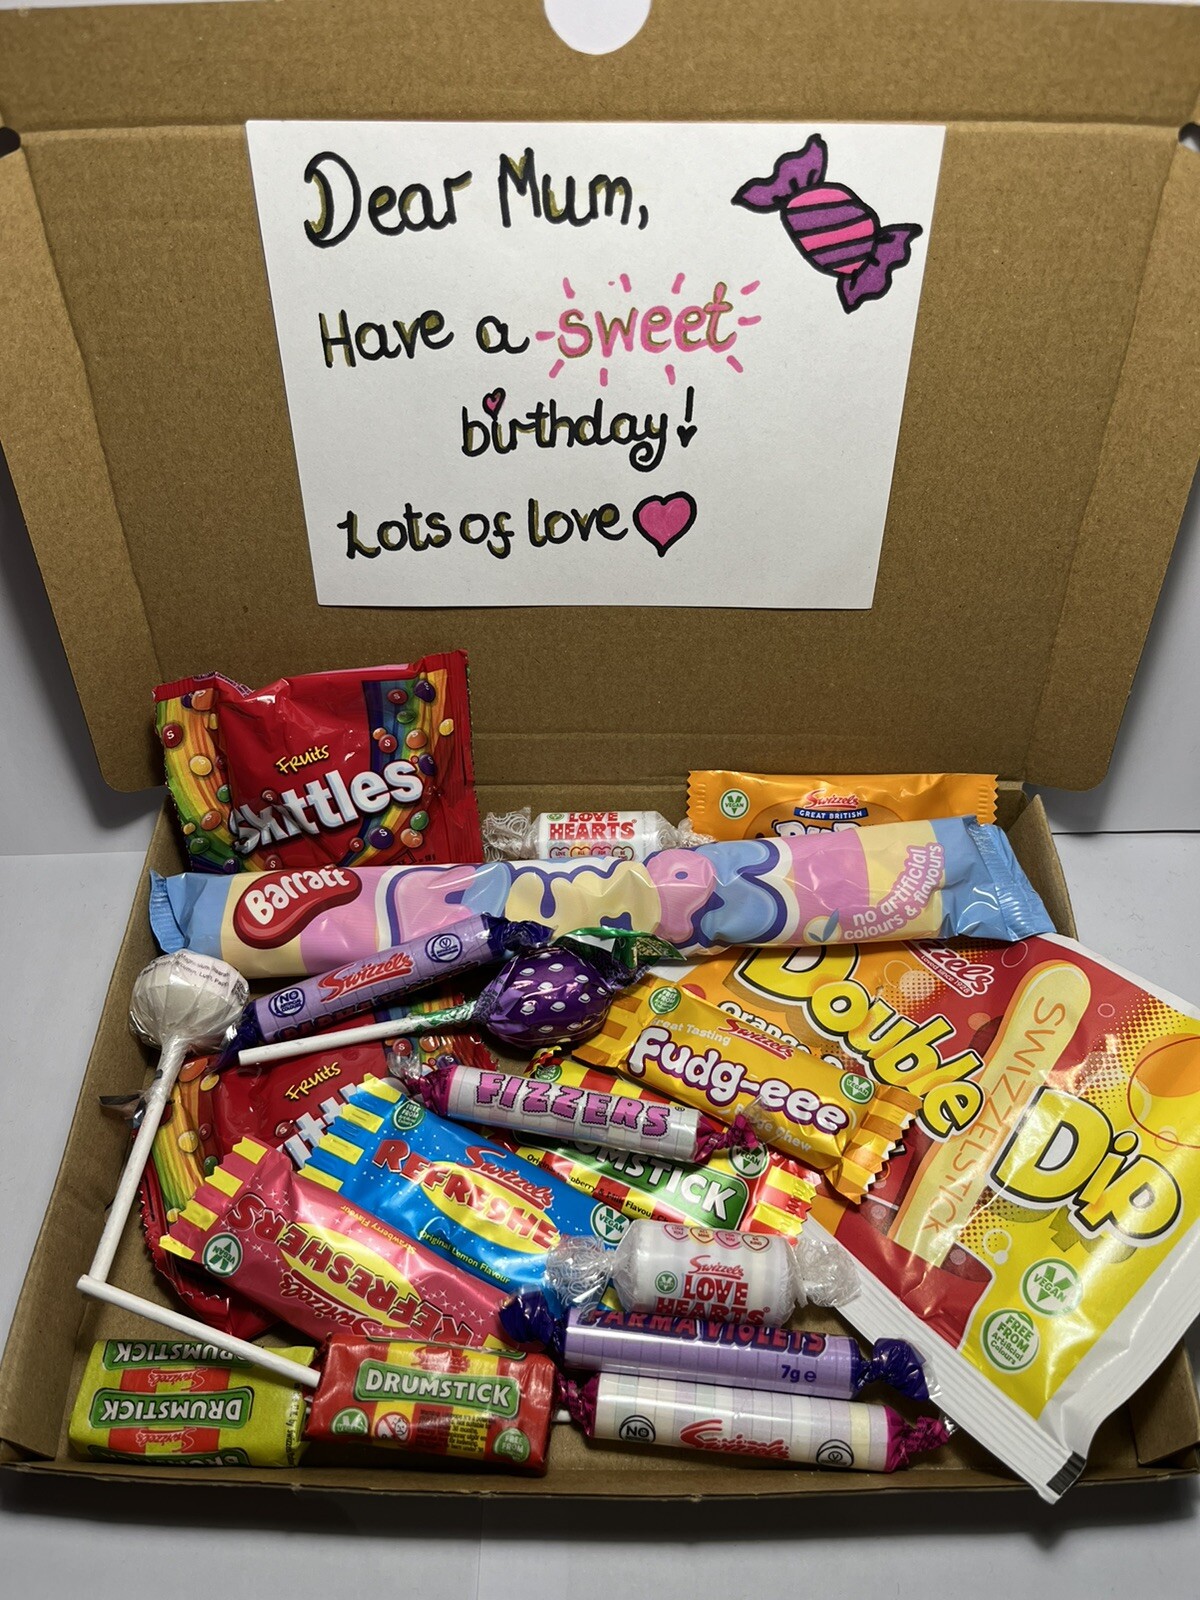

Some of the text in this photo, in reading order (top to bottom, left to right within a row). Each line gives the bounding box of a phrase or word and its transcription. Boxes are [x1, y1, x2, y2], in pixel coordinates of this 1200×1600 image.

[304, 148, 650, 249] Dear Mum,
[320, 282, 738, 368] Have a sweet
[461, 387, 698, 472] birthday!
[338, 498, 629, 560] Lots of love
[228, 760, 424, 855] Skittles
[725, 801, 744, 809] VEGAN
[803, 789, 860, 809] Swizzels
[568, 812, 619, 823] LOVE
[799, 809, 863, 820] GREAT BRITISH
[549, 820, 635, 841] HEARTS
[245, 868, 350, 925] Barratt
[844, 845, 942, 940] colours & flavours
[853, 848, 927, 927] no artificial
[318, 952, 415, 1002] Swizzels
[937, 968, 955, 982] since
[281, 990, 299, 1003] NO
[686, 1023, 731, 1046] Tasting
[718, 1018, 795, 1060] Swizzels
[738, 943, 983, 1139] Double
[629, 1027, 848, 1134] Fudg-eee
[846, 1080, 870, 1097] VEGAN
[476, 1072, 670, 1137] FIZZERS
[736, 1149, 760, 1167] VEGAN
[995, 1087, 1181, 1241] Dip
[457, 1146, 555, 1211] Swizzels
[340, 1204, 417, 1255] Strawberry Flavour
[599, 1212, 625, 1235] VEGAN
[213, 1244, 236, 1264] VEGAN
[419, 1230, 511, 1285] Original Lemon Flavour
[688, 1255, 745, 1280] Swizzels
[227, 1194, 475, 1347] REFRESHERS
[278, 1267, 384, 1336] Swizzels
[683, 1275, 748, 1306] LOVE
[1033, 1273, 1067, 1302] VEGAN
[655, 1297, 765, 1326] HEARTS
[706, 1320, 828, 1355] VIOLETS
[997, 1322, 1029, 1353] FROM
[1005, 1314, 1034, 1342] FREE
[991, 1332, 1024, 1362] Artificial
[991, 1341, 1016, 1365] Colours
[149, 1368, 208, 1388] Swizzels
[364, 1368, 511, 1408] DRUMSTICK
[781, 1365, 801, 1383] 7g
[100, 1400, 243, 1421] DRUMSTICK
[136, 1427, 198, 1453] Swizzels
[626, 1425, 650, 1438] NO
